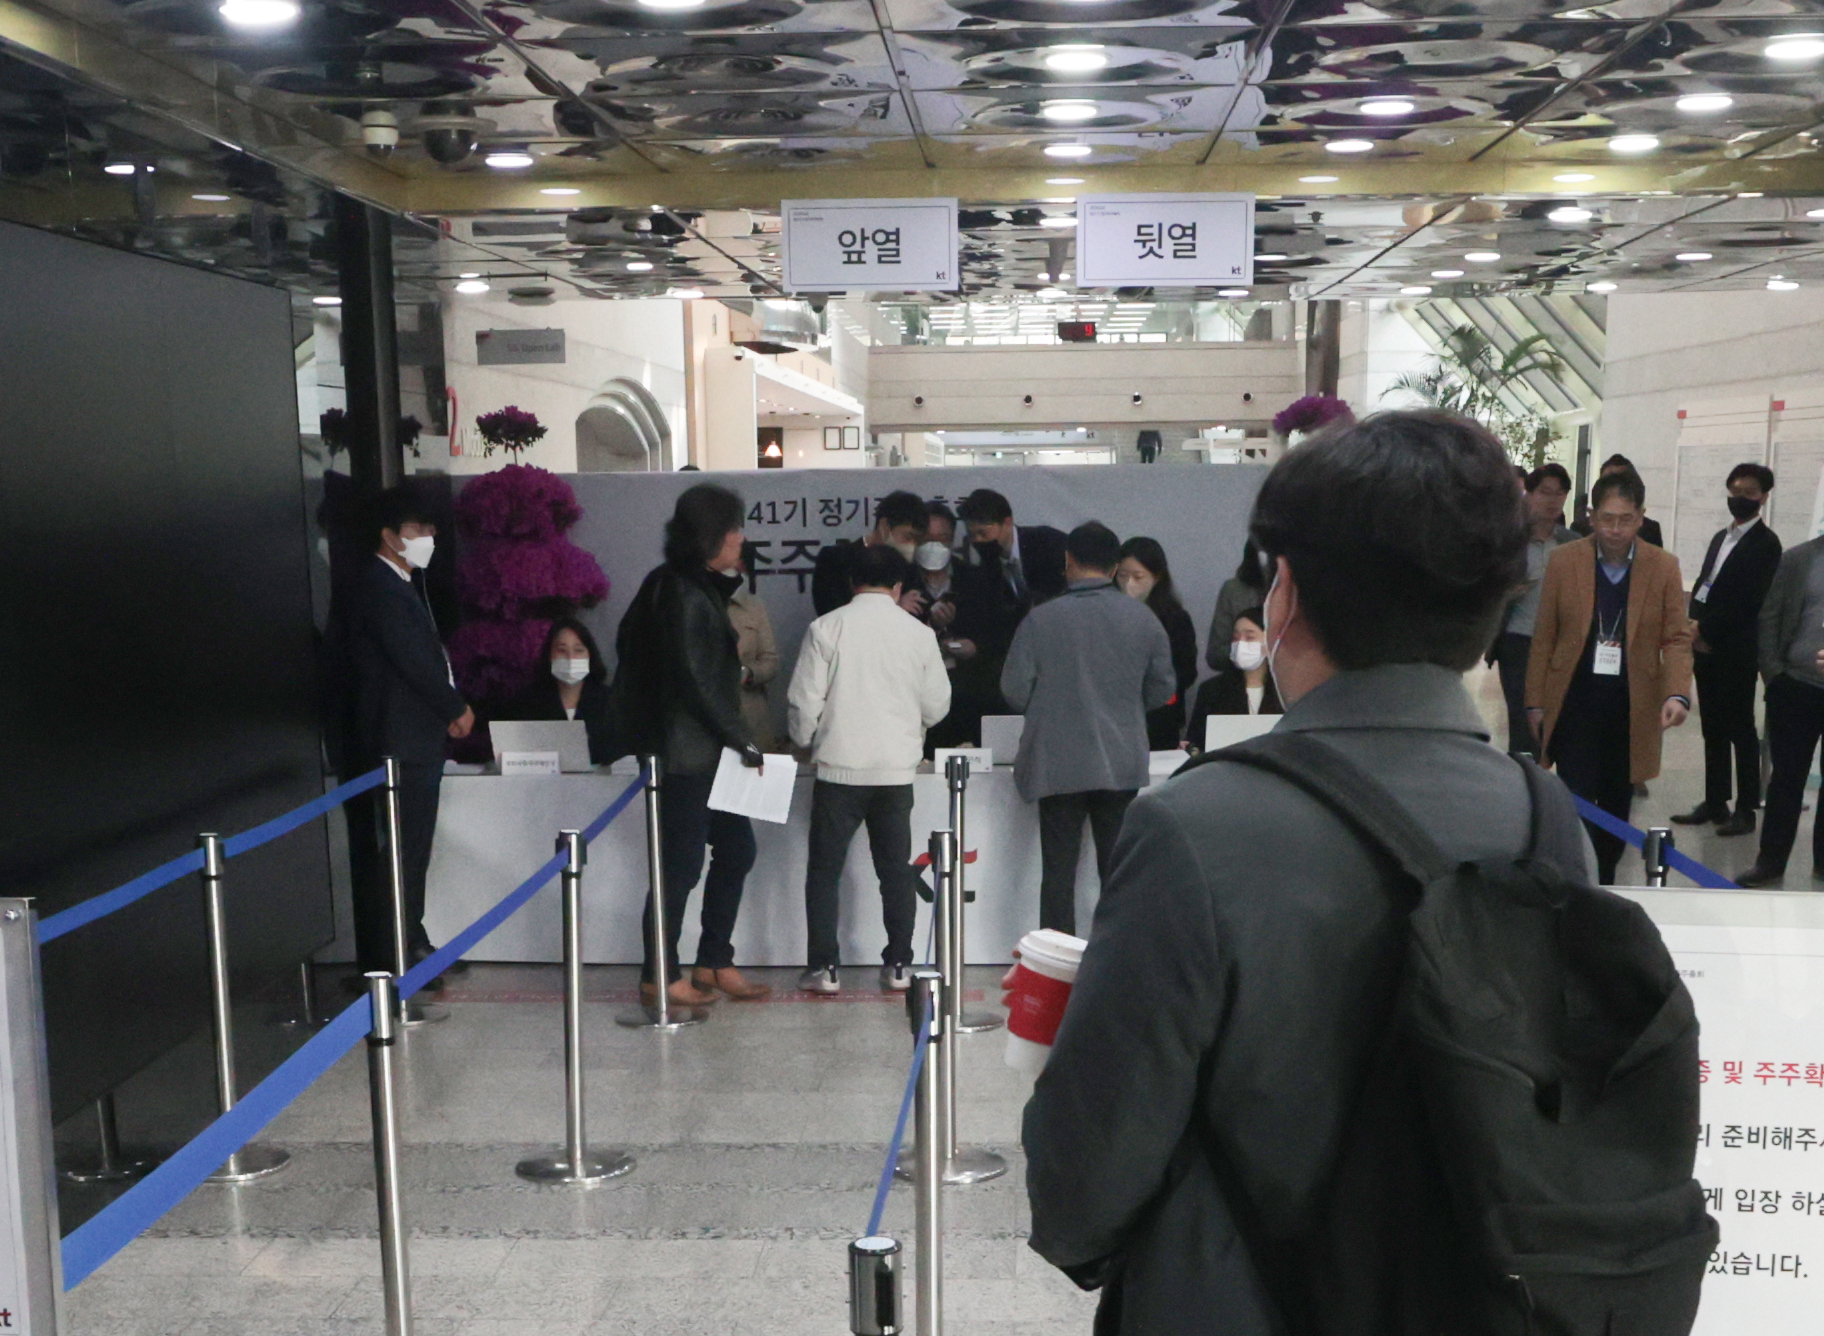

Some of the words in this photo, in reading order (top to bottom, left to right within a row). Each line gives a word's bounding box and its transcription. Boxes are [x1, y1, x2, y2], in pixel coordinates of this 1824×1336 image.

[837, 226, 902, 265] 앞열
[1133, 221, 1198, 260] 뒷열
[934, 270, 948, 282] kt
[1229, 264, 1244, 277] kt
[742, 497, 808, 528] 41기
[1722, 1060, 1743, 1085] 및
[1734, 1188, 1782, 1215] 입장
[1708, 1251, 1809, 1280] 있습니다.
